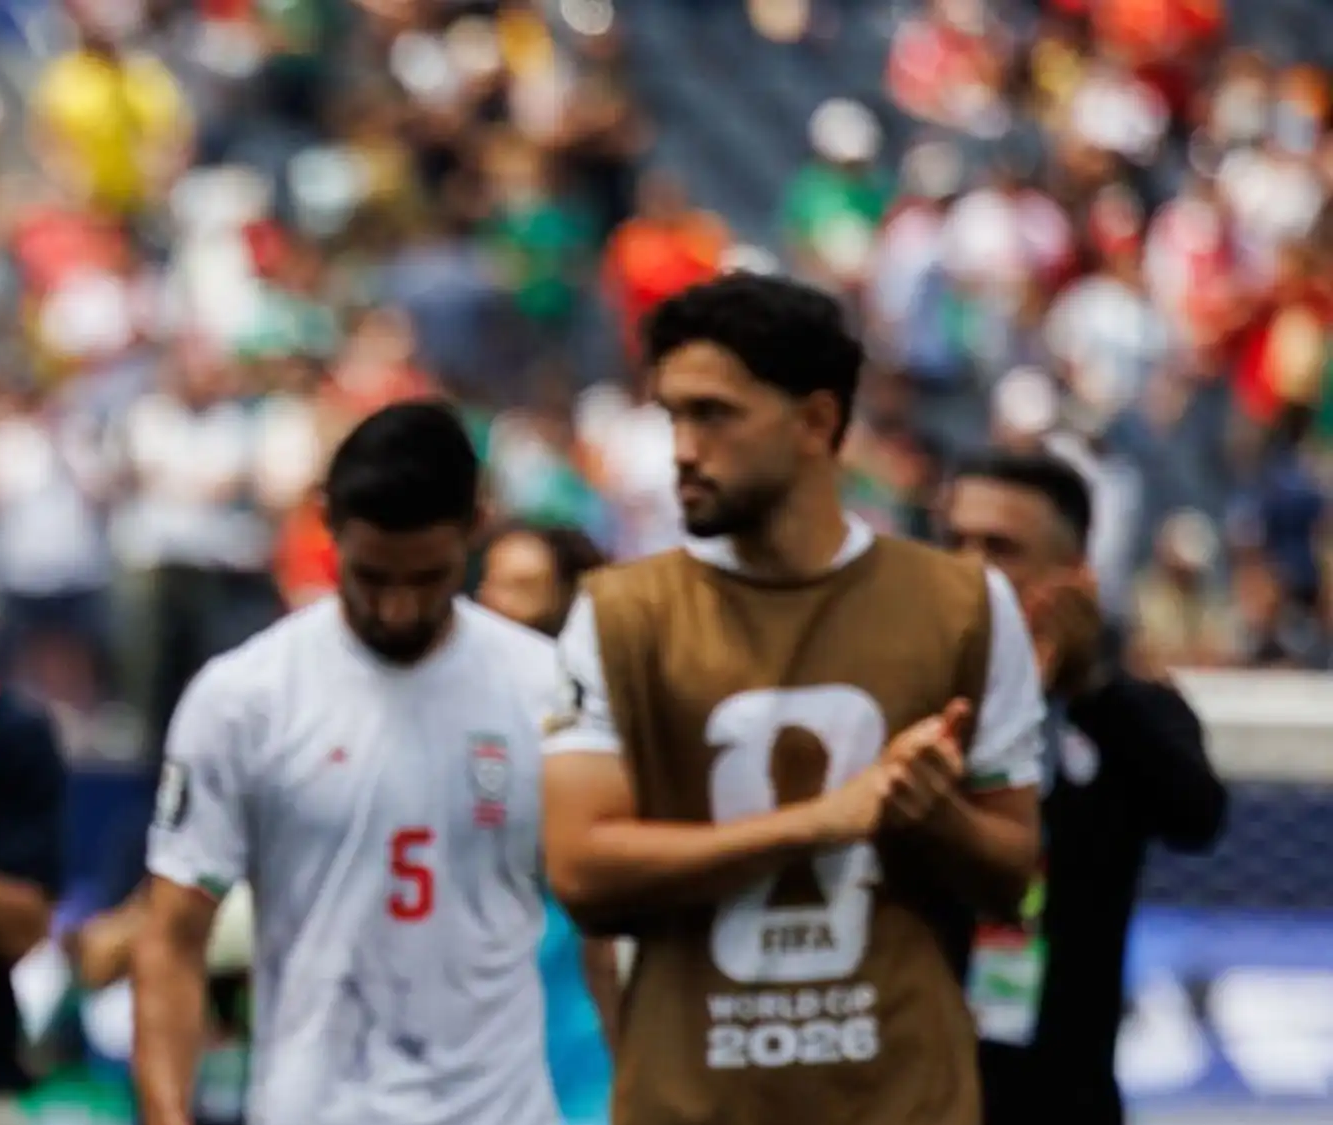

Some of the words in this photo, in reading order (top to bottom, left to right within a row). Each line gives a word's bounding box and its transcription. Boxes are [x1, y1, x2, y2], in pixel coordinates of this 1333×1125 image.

[385, 827, 435, 923] 5
[706, 990, 821, 1022] WORLD
[706, 1016, 880, 1068] 2026
